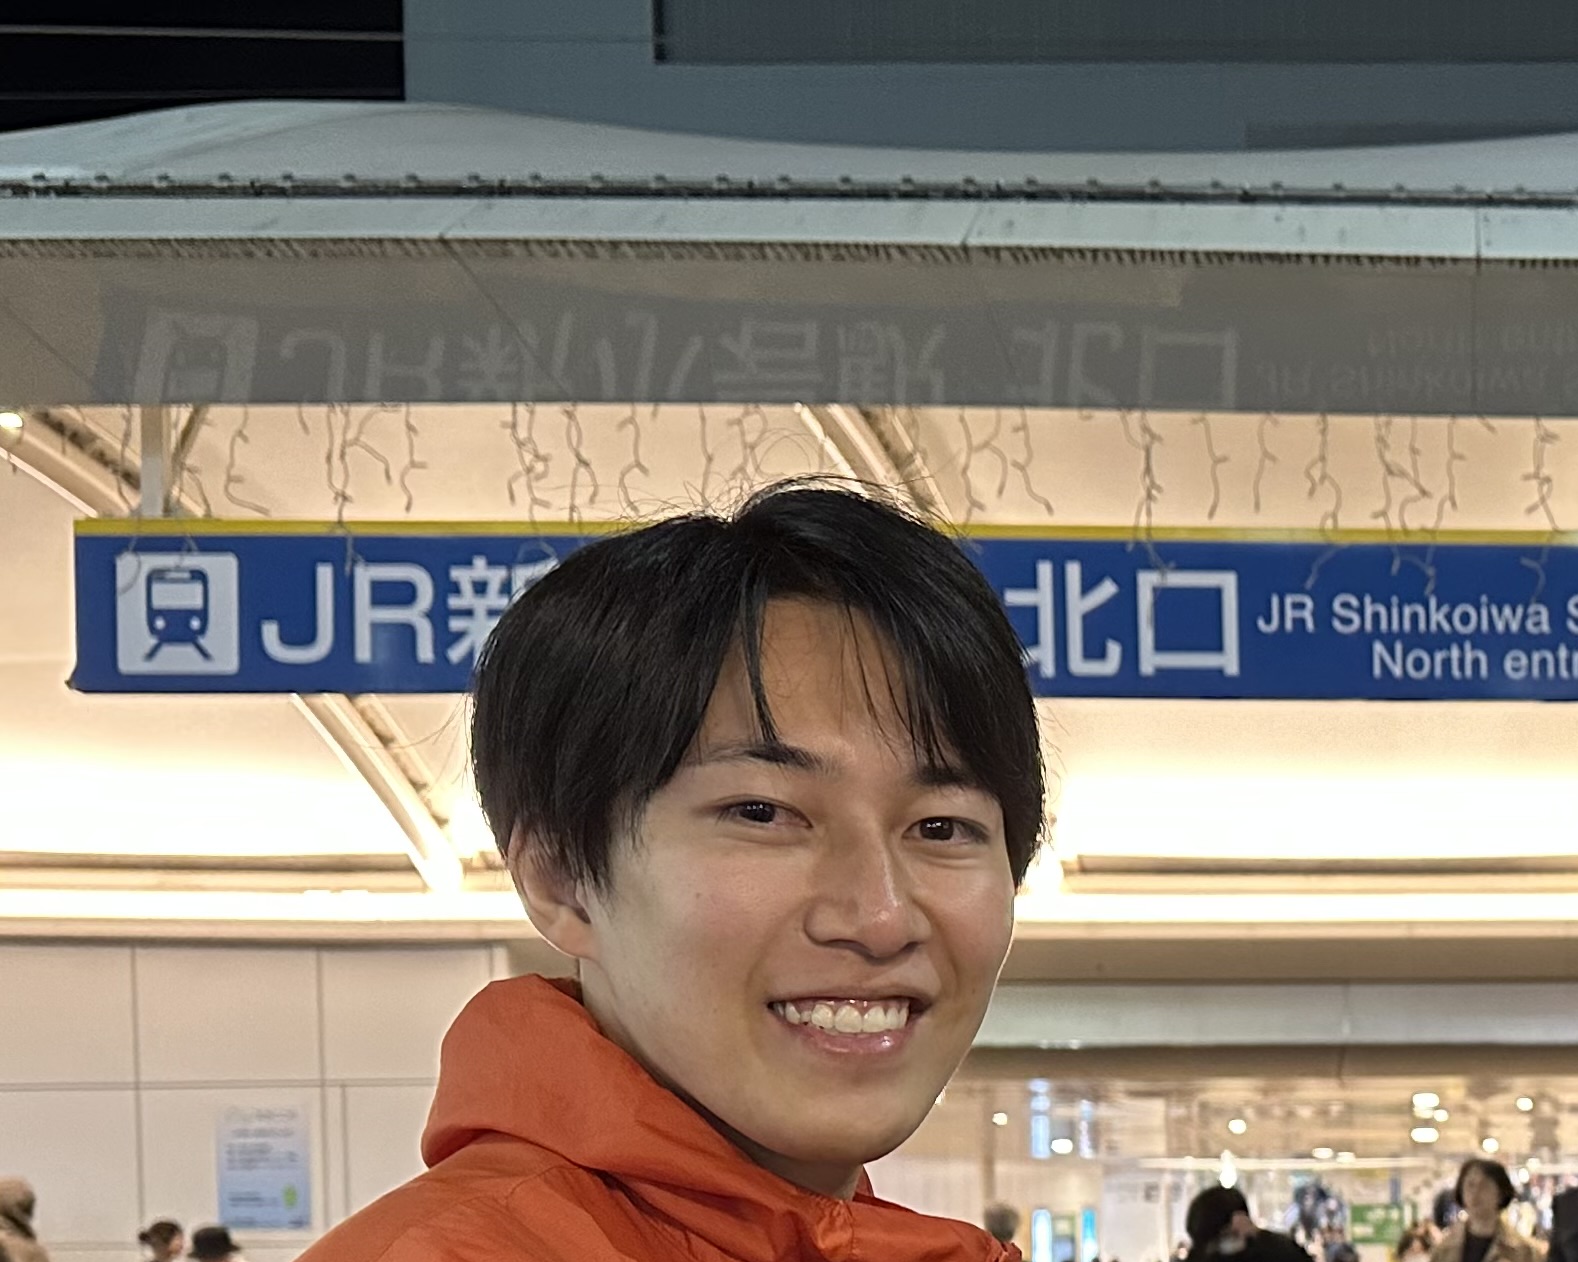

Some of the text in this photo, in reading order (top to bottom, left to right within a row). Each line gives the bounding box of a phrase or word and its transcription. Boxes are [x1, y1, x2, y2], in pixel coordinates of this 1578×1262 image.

[1004, 560, 1240, 678] 北口
[1256, 592, 1316, 635] JR
[1330, 592, 1552, 635] Shinkoiwa
[1372, 639, 1490, 680] North
